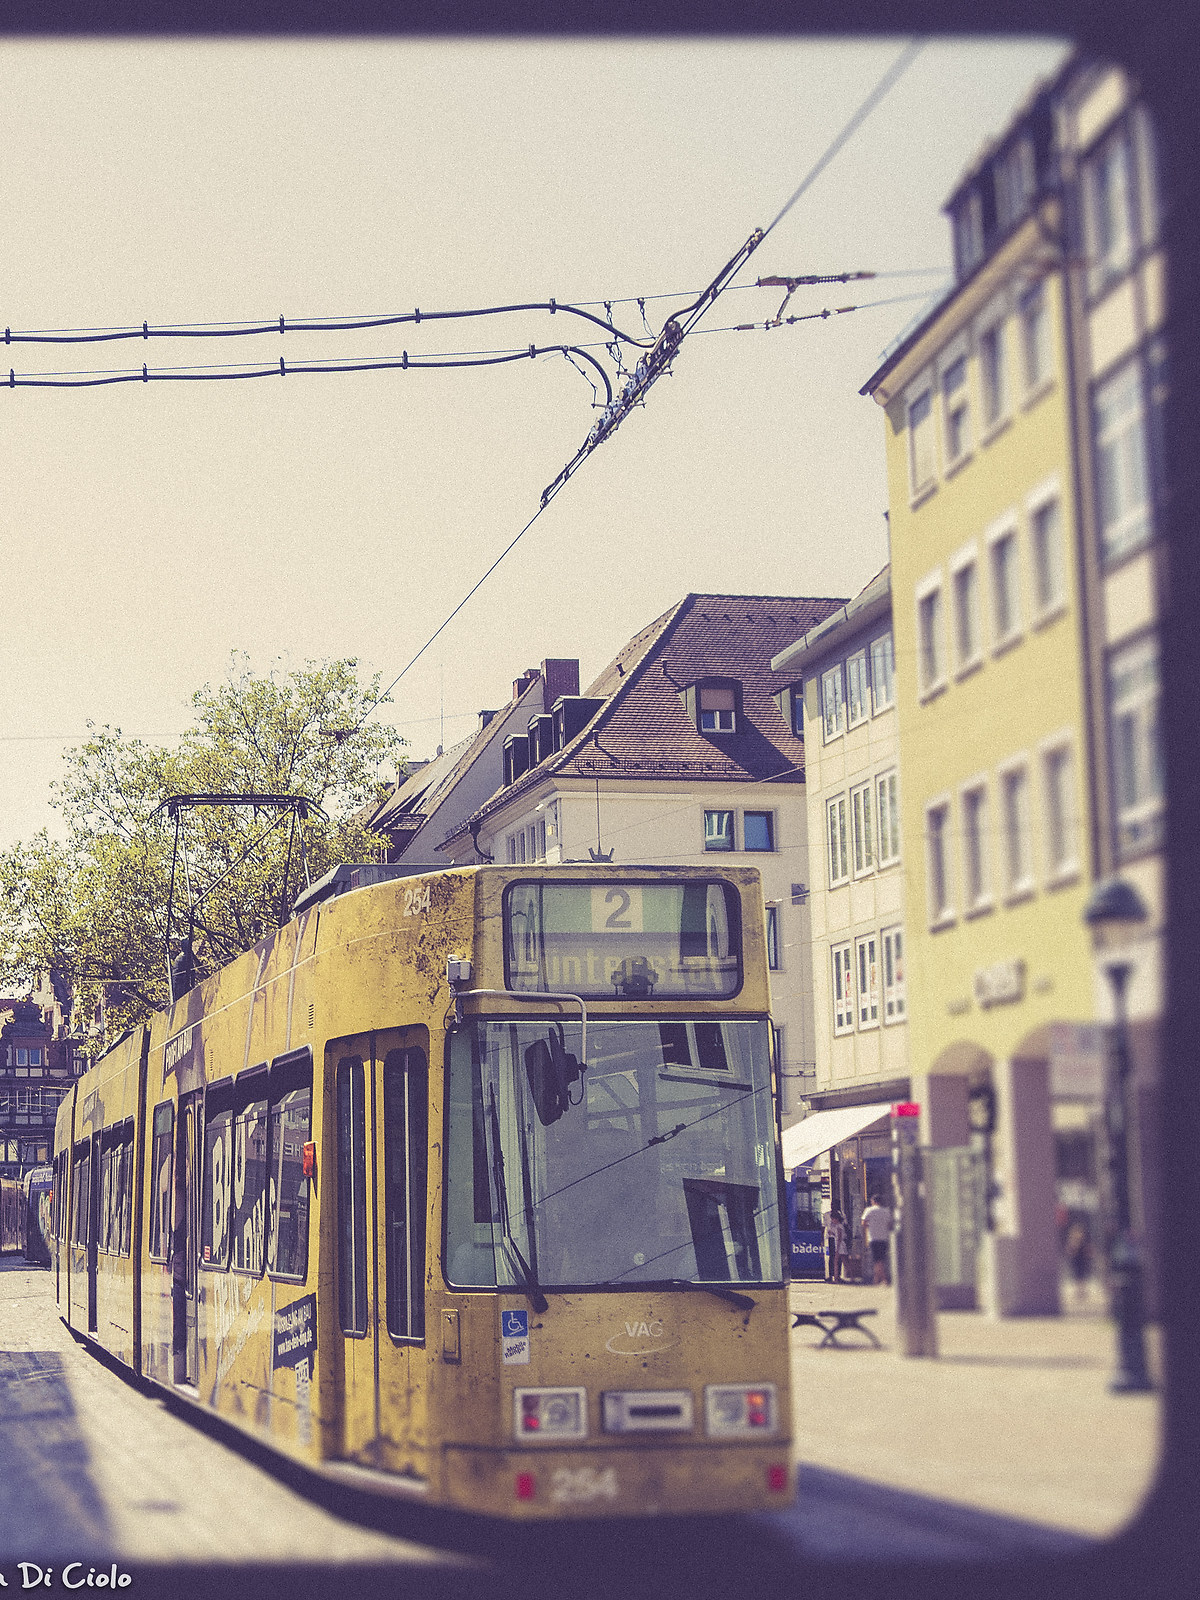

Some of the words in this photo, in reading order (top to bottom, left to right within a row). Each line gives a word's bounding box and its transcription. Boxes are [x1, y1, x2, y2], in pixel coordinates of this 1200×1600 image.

[403, 886, 432, 917] 254
[604, 887, 632, 928] 2
[624, 1321, 663, 1337] VAG
[504, 1346, 525, 1359] Rampe
[506, 1341, 526, 1353] Mobile
